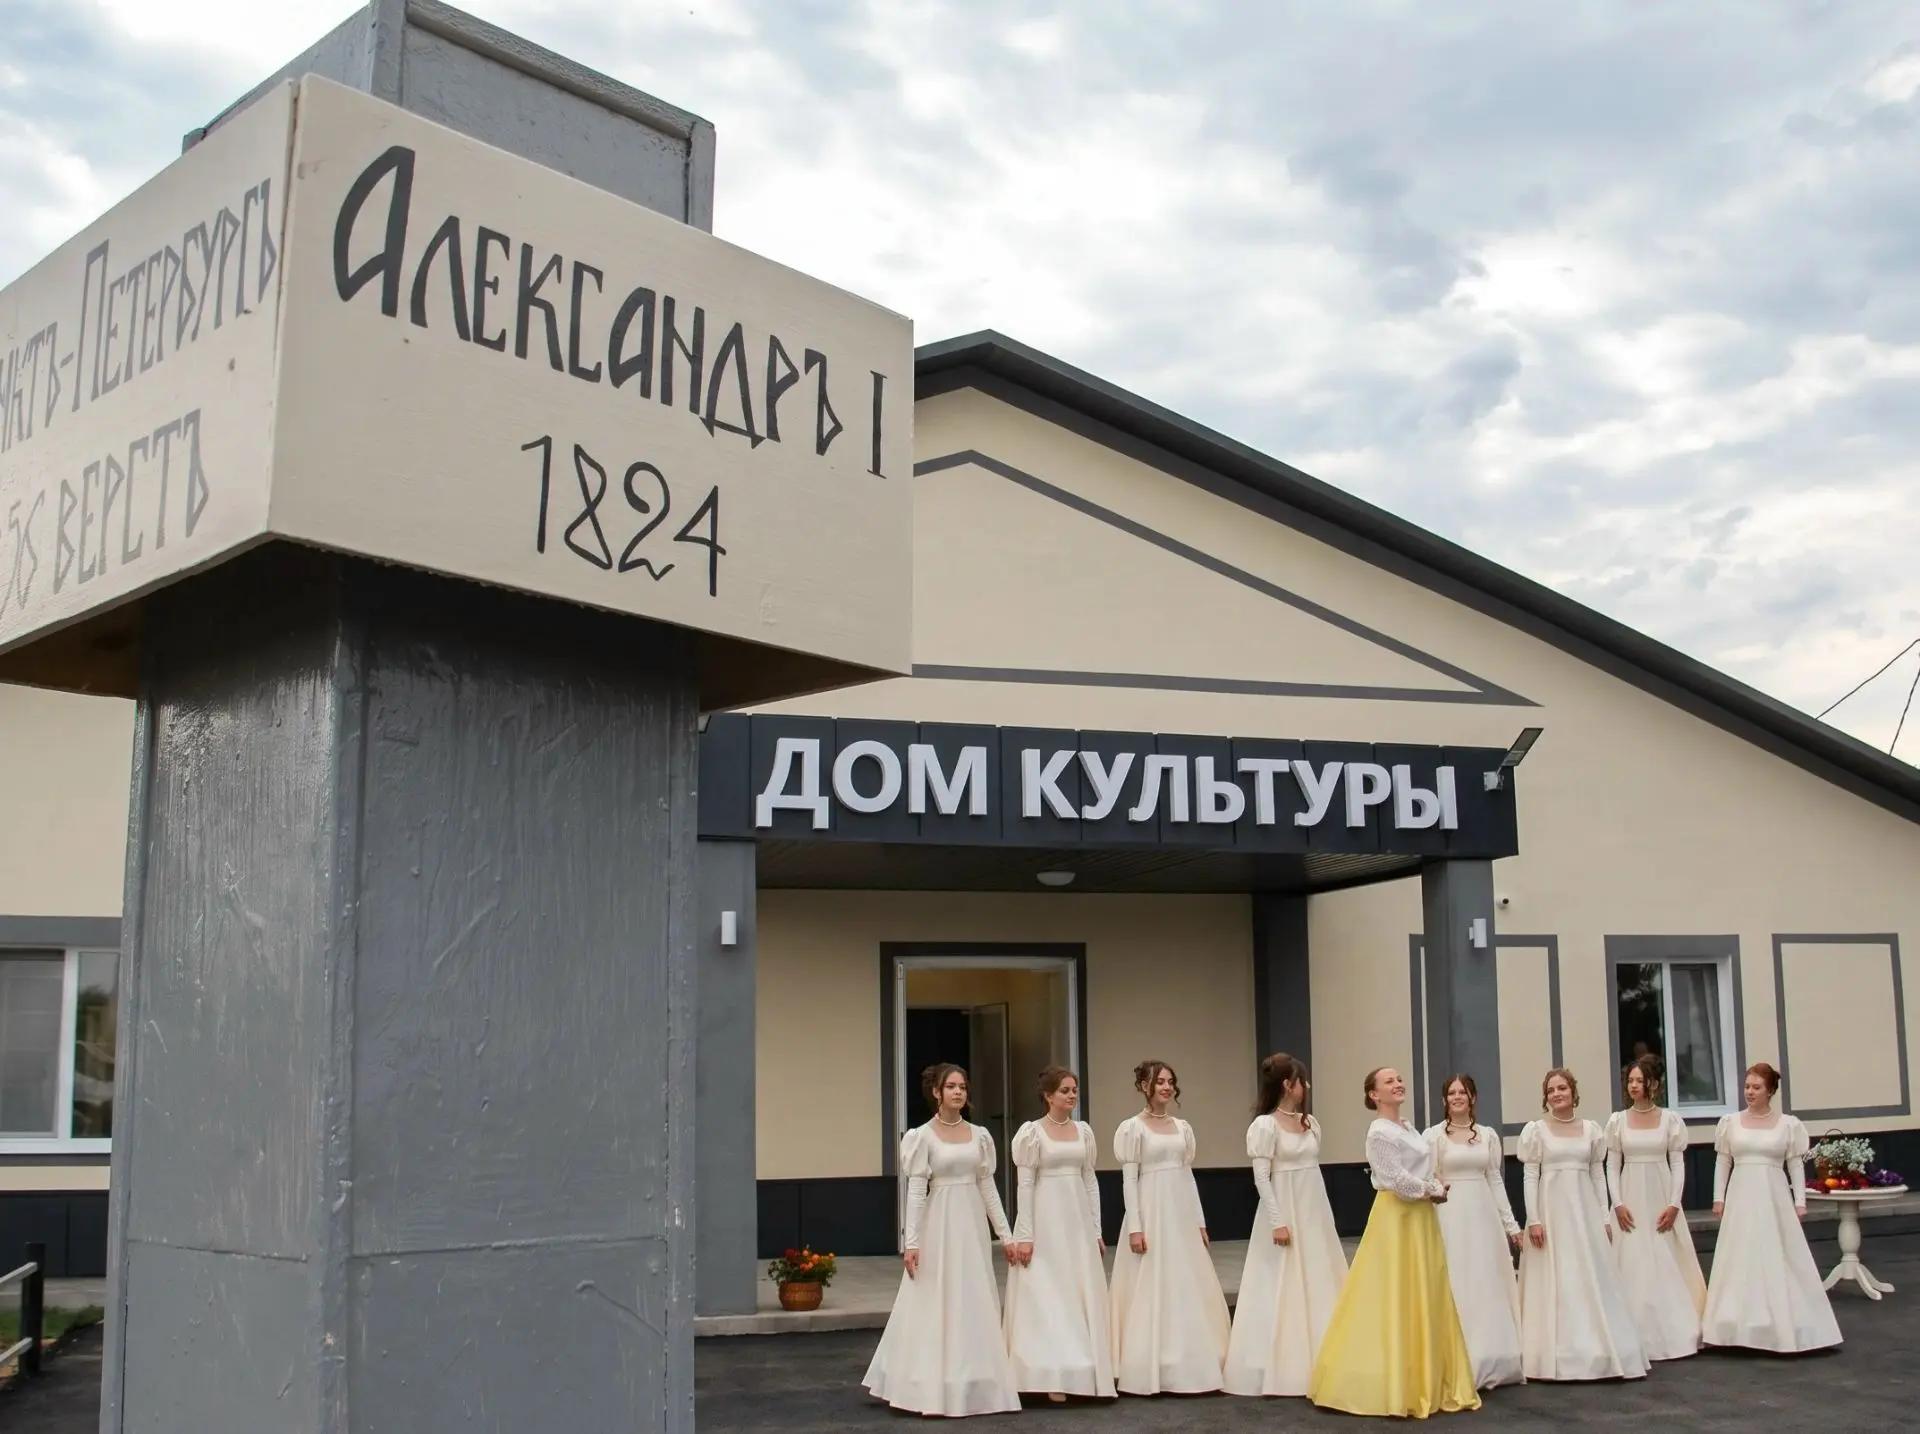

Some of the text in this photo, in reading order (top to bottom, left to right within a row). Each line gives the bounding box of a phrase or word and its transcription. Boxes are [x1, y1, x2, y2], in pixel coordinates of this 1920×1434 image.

[53, 409, 209, 595] ВЕРСТЪ
[521, 435, 726, 597] 1824
[755, 737, 1459, 830] ДОМ КУЛЬТУРЫ
